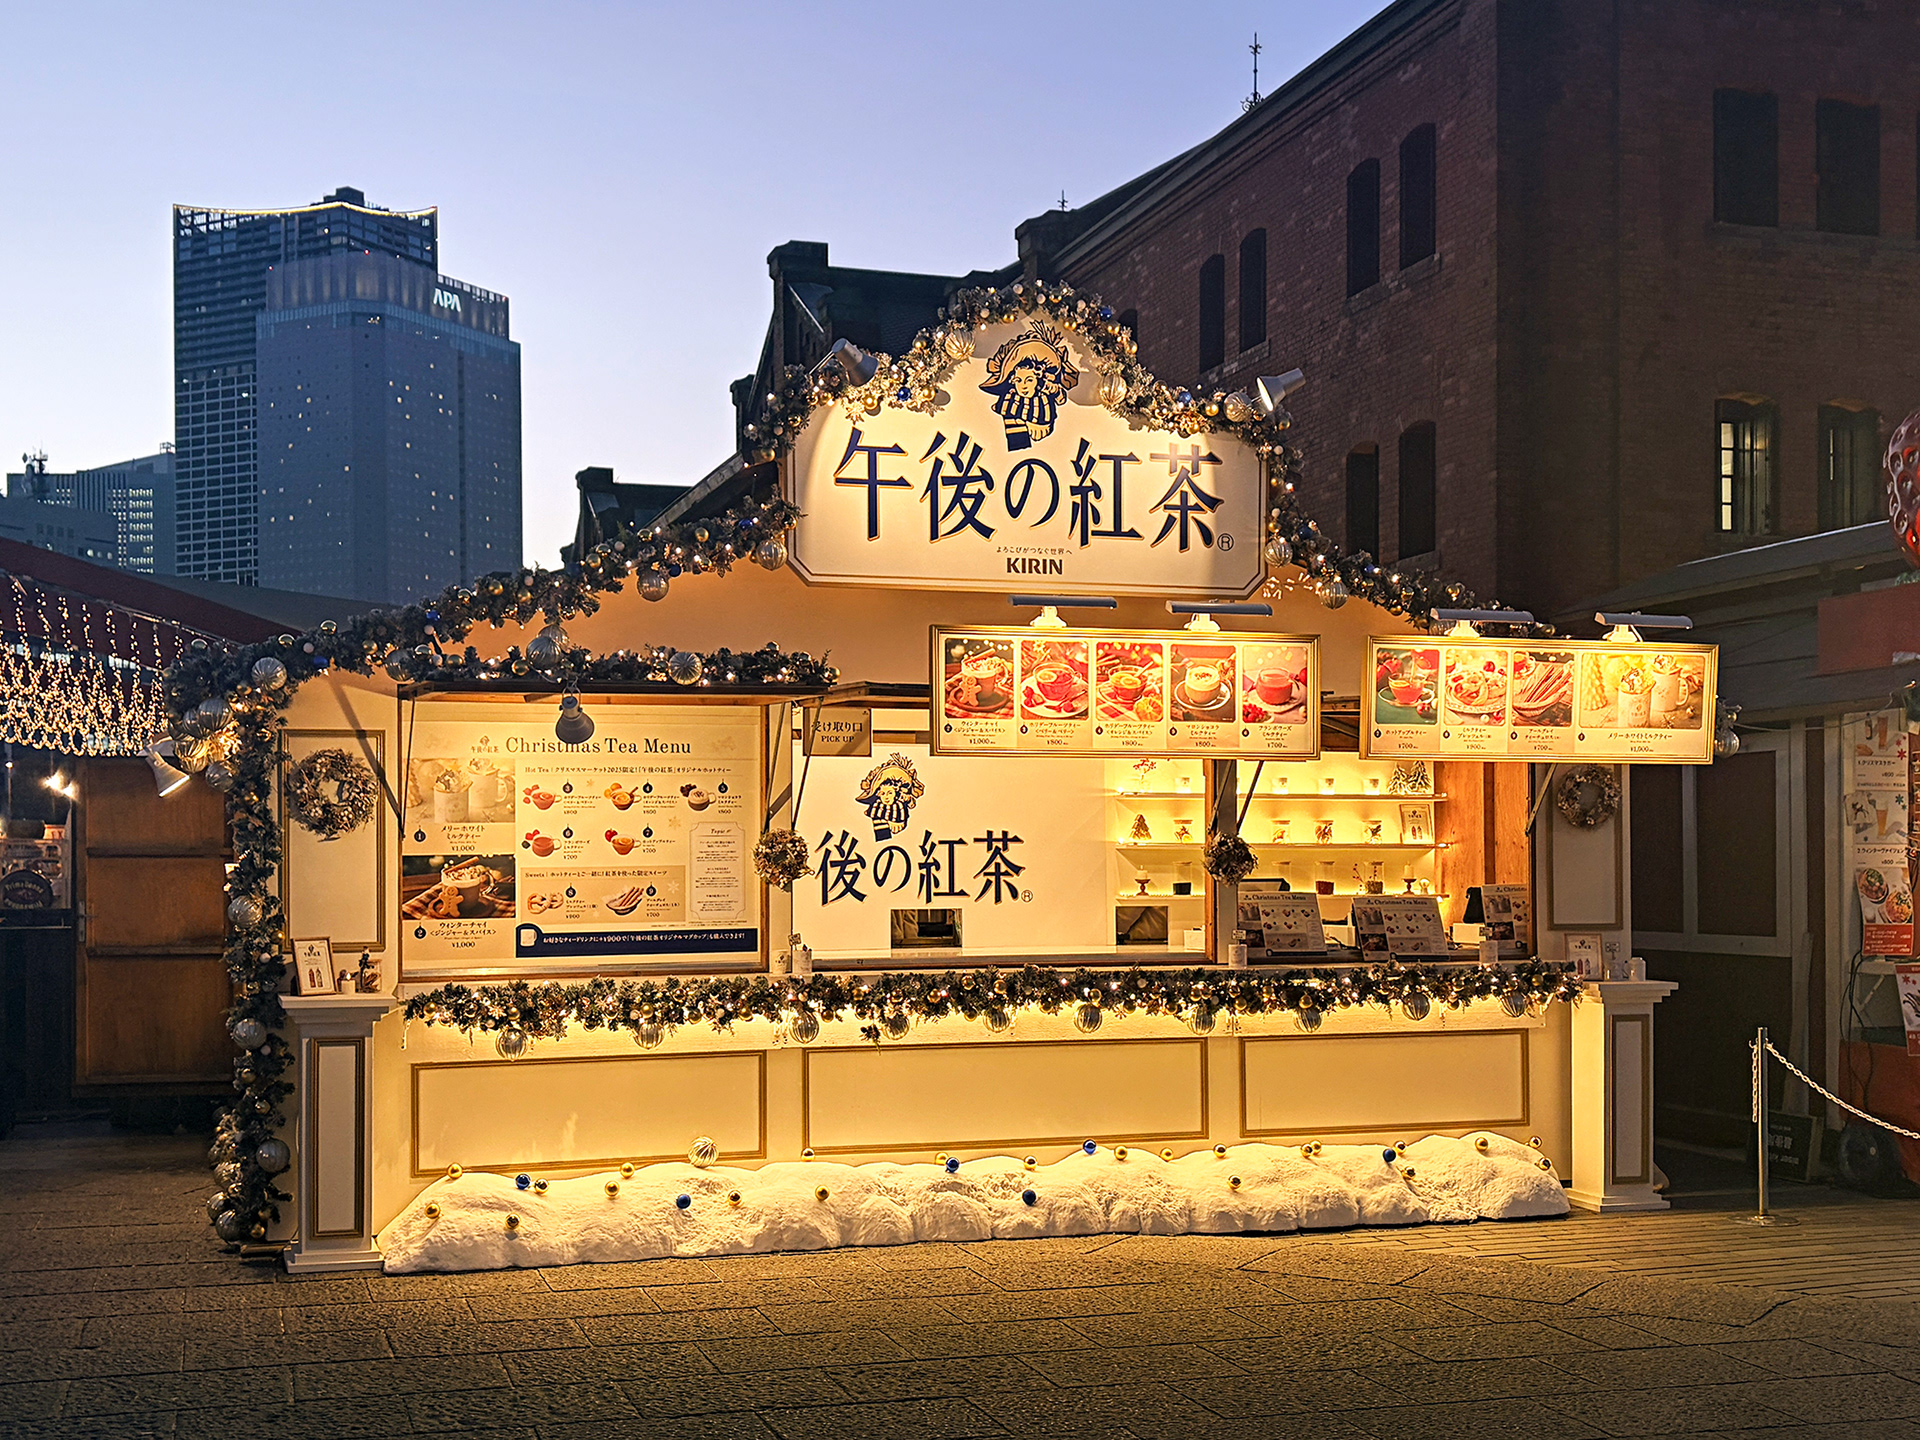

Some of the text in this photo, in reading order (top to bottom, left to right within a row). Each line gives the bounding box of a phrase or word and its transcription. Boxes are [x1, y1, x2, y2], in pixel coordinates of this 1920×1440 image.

[433, 288, 461, 312] APA
[834, 426, 1225, 553] 午後の紅茶
[996, 546, 1073, 555] よろこびがつなぐ世界へ
[1006, 557, 1063, 575] KIRIN
[811, 721, 863, 732] 受け取り口
[506, 737, 691, 754] Christmas Tea Menu
[821, 735, 855, 743] PICK UP
